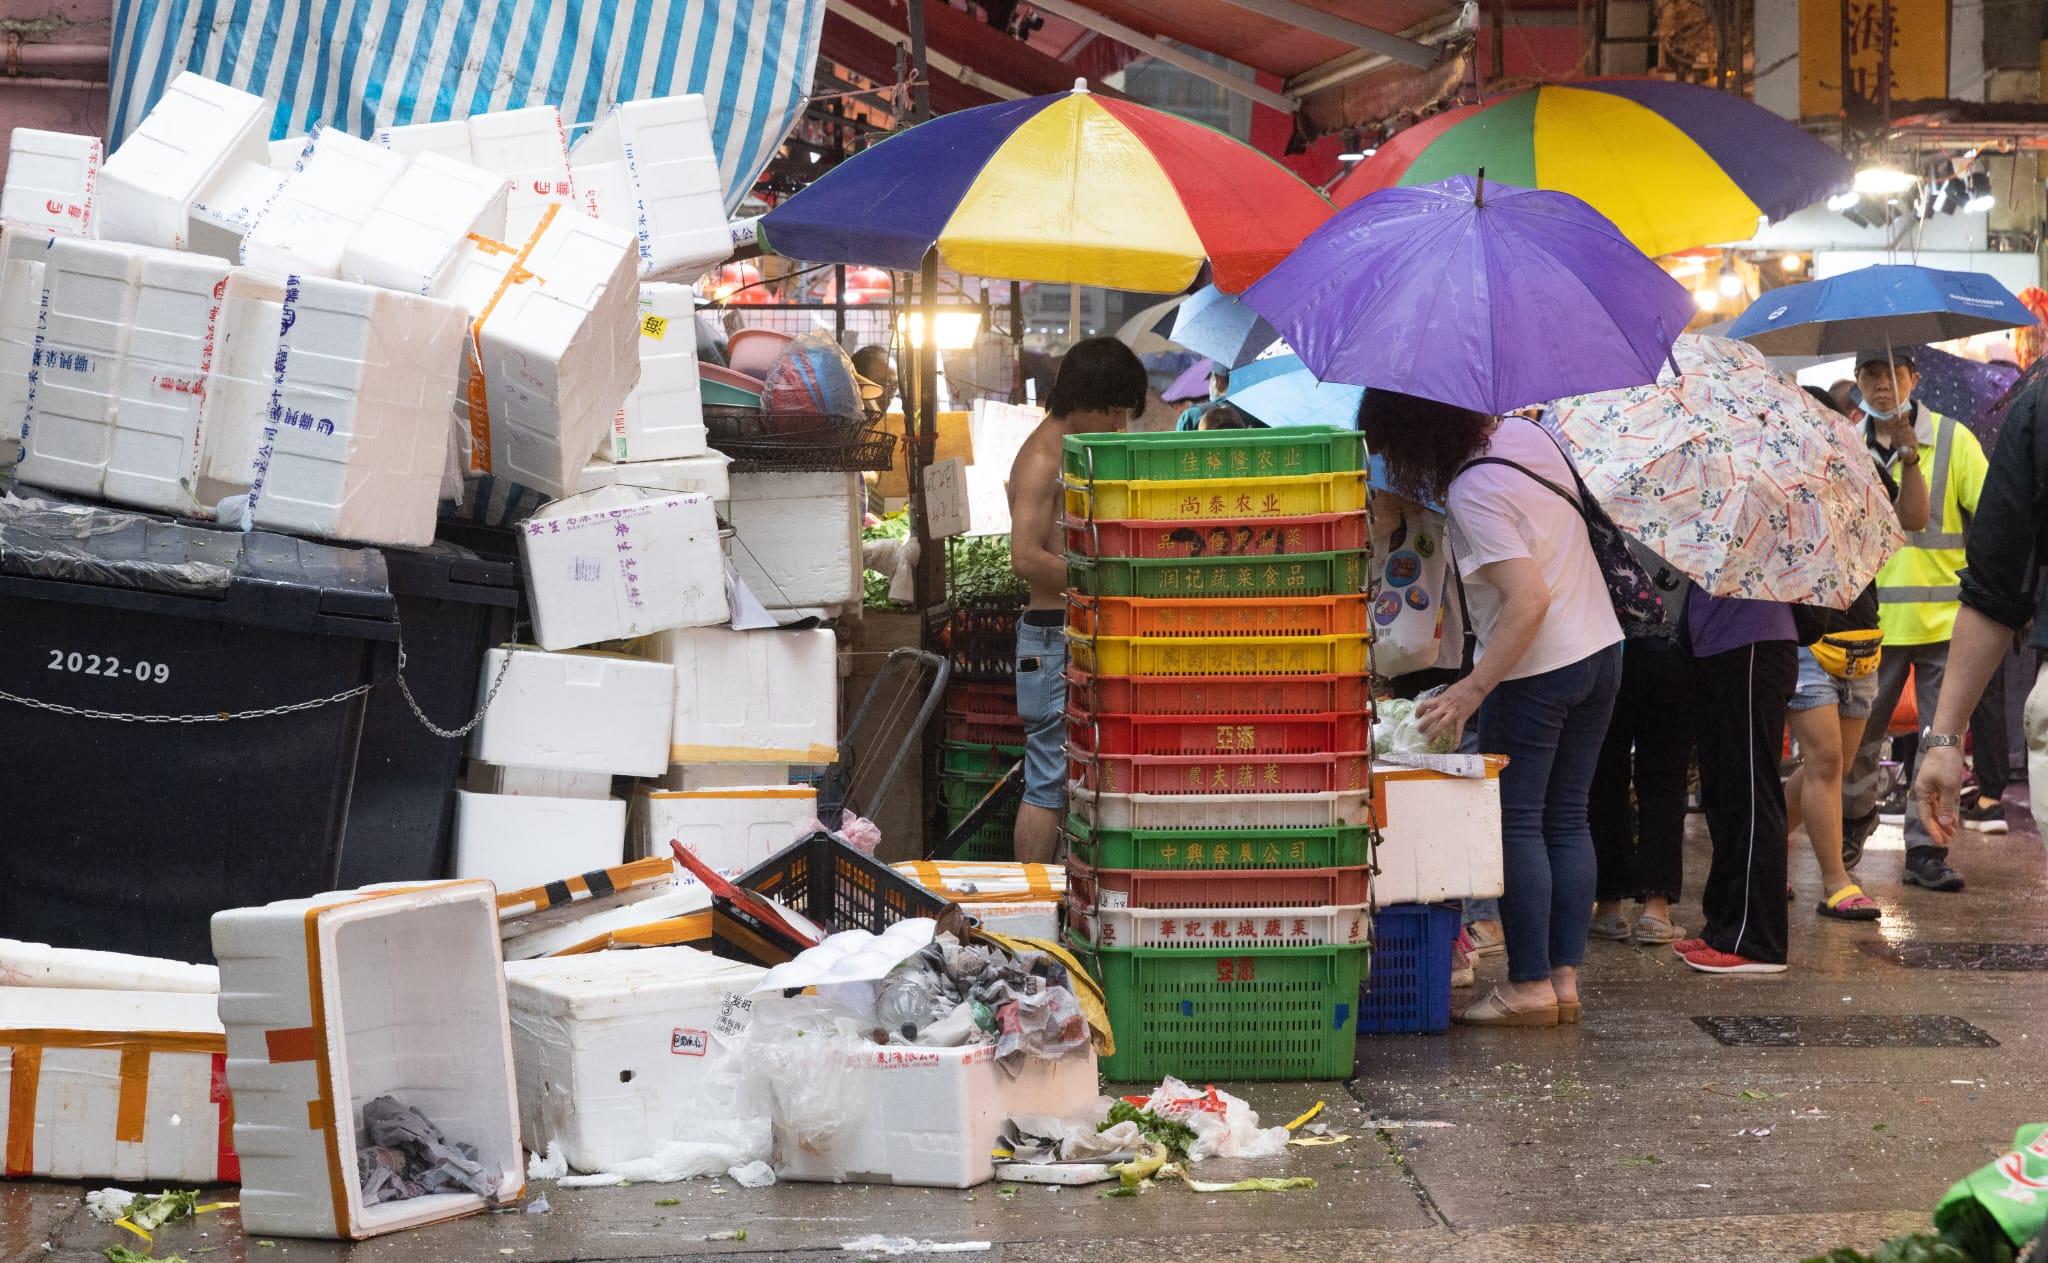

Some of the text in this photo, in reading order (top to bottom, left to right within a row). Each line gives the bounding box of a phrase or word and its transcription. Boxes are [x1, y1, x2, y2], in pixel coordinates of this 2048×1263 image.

[1181, 448, 1301, 472] 佳裕隆农业
[1181, 493, 1281, 514] 尚泰农业
[1160, 565, 1305, 588] 润记蔬菜食品
[48, 650, 170, 684] 2022-09
[1186, 764, 1281, 788] 農夫蔬菜
[1161, 842, 1306, 865] 中興發展公司
[1160, 919, 1309, 939] 華記龍城蔬菜
